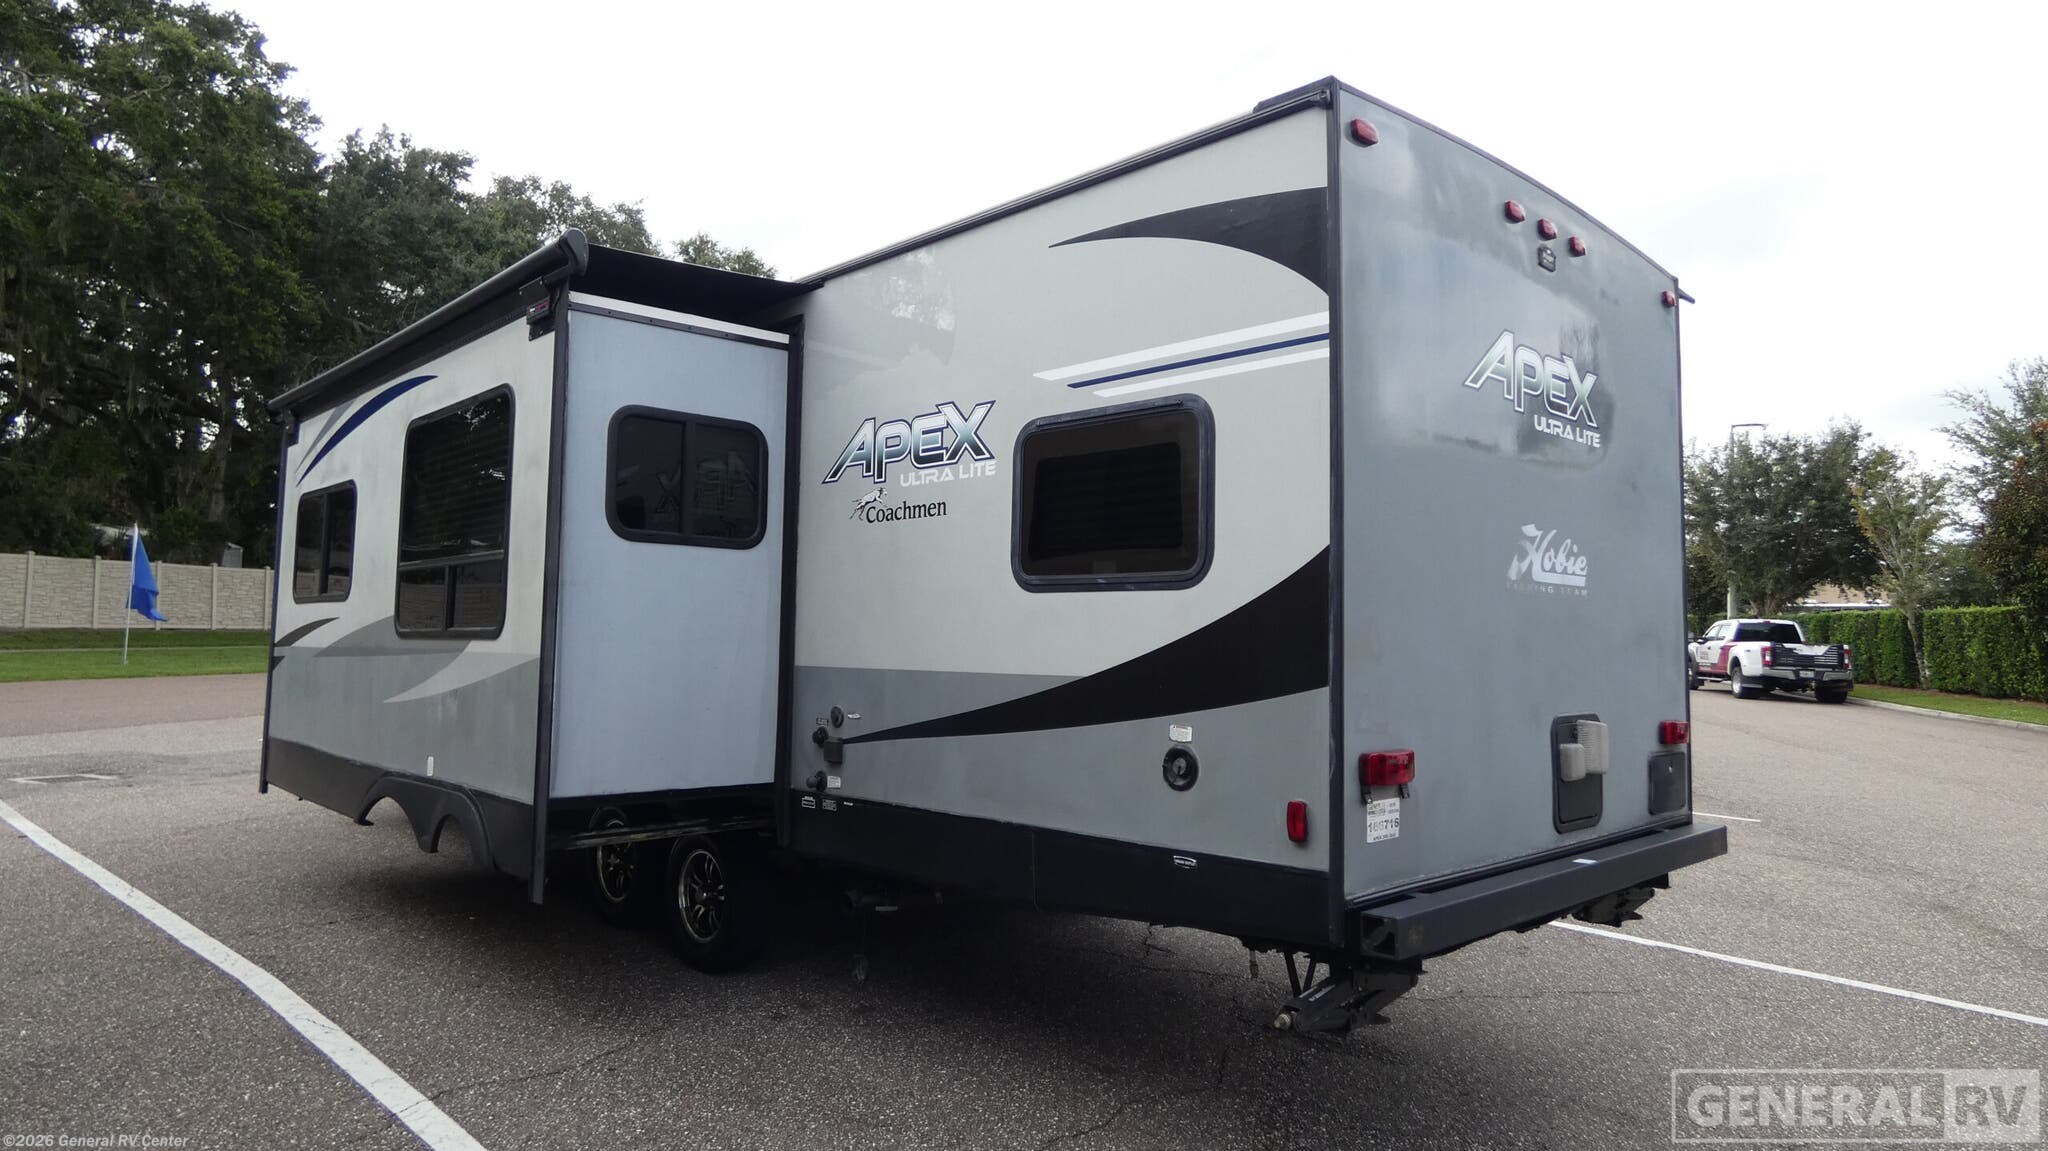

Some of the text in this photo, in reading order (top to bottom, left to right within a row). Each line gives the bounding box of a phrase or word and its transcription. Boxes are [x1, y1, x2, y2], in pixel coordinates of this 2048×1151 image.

[1463, 329, 1599, 428] APEX
[822, 400, 996, 484] APEX
[1534, 414, 1600, 448] ULTRA LITE
[900, 460, 997, 487] ULTRA LITE
[865, 501, 948, 524] Coachmen
[1507, 523, 1588, 587] Hobie
[1368, 817, 1400, 832] 1716
